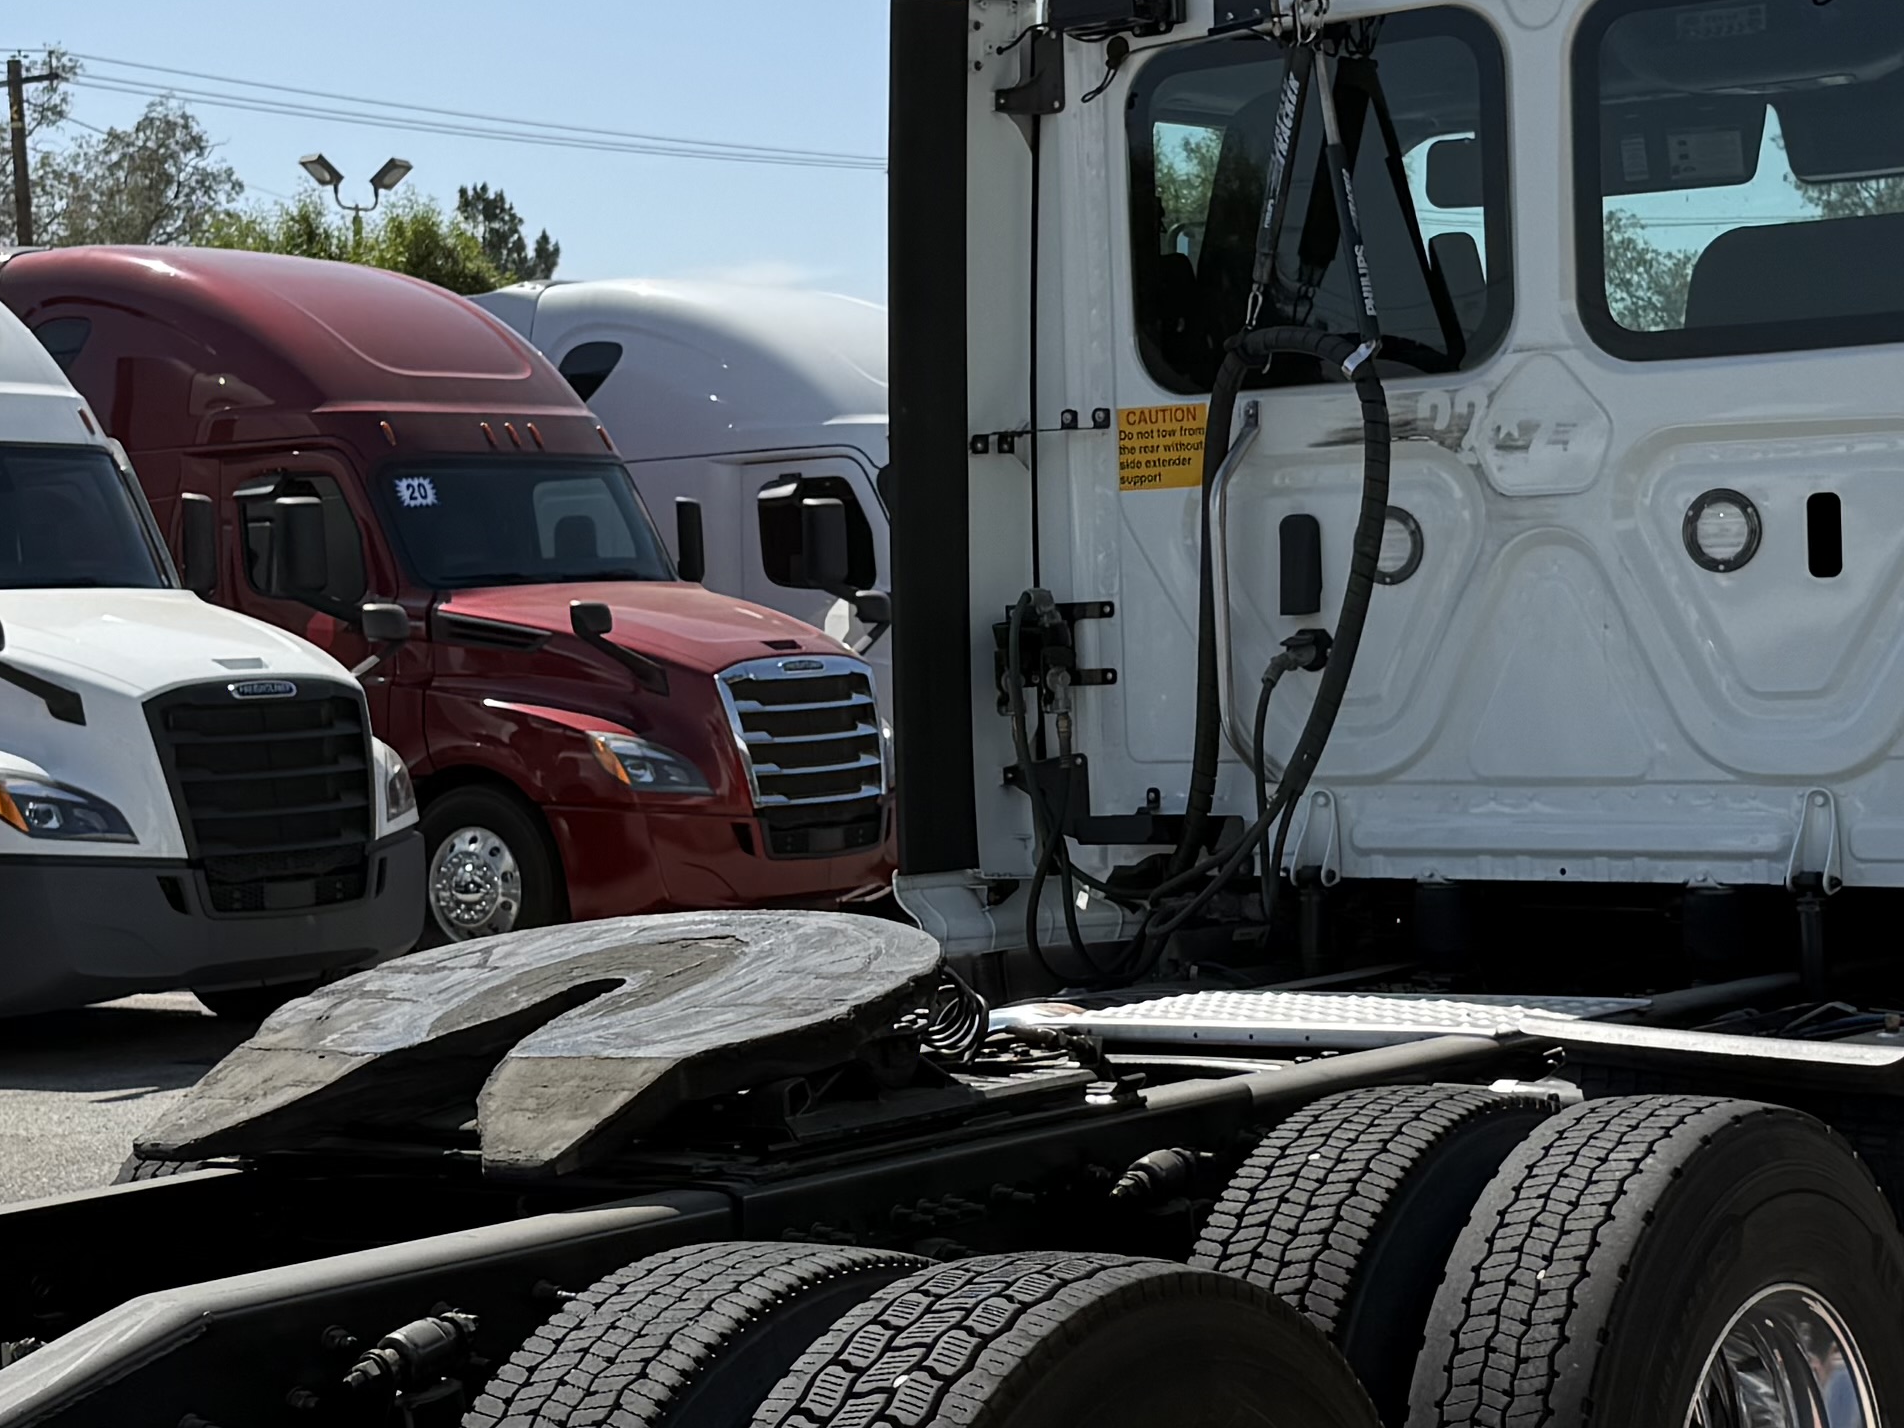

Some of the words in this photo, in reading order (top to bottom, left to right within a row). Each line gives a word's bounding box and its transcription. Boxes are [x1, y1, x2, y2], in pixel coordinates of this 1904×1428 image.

[1126, 406, 1197, 426] CAUTION
[1119, 430, 1134, 441] Do
[1136, 429, 1154, 440] not
[1157, 428, 1176, 439] tow
[1179, 426, 1205, 437] from
[1119, 444, 1136, 455] the
[1139, 444, 1160, 454] rear
[1163, 440, 1203, 452] without
[1119, 458, 1142, 470] side
[1145, 456, 1192, 469] extender
[1120, 472, 1162, 486] support
[406, 482, 428, 500] 20
